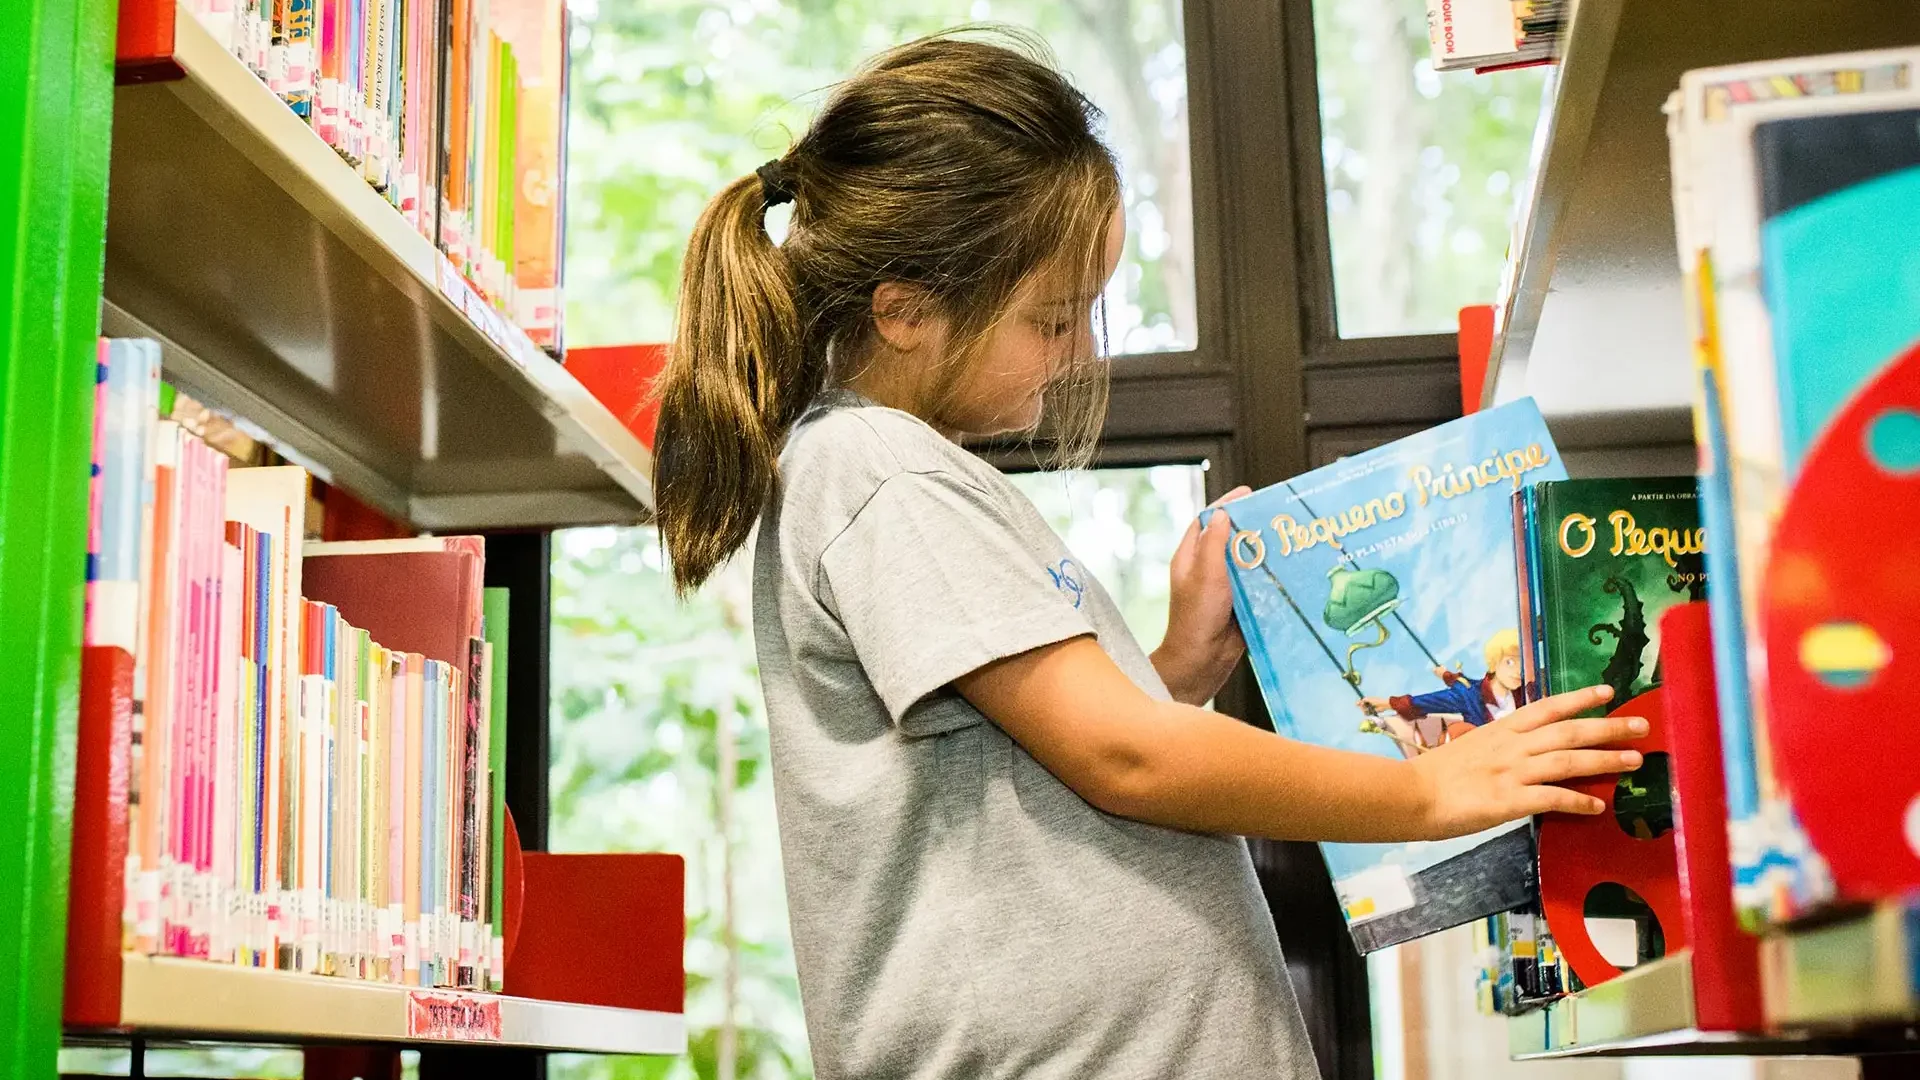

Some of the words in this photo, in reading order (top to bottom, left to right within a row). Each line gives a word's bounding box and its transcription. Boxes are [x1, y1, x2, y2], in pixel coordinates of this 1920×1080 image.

[1444, 26, 1455, 54] BOOK
[1637, 493, 1664, 501] PARTIR
[1231, 530, 1266, 569] O
[1271, 492, 1405, 557] Pequeno
[1558, 513, 1597, 558] O
[1678, 573, 1695, 582] NO
